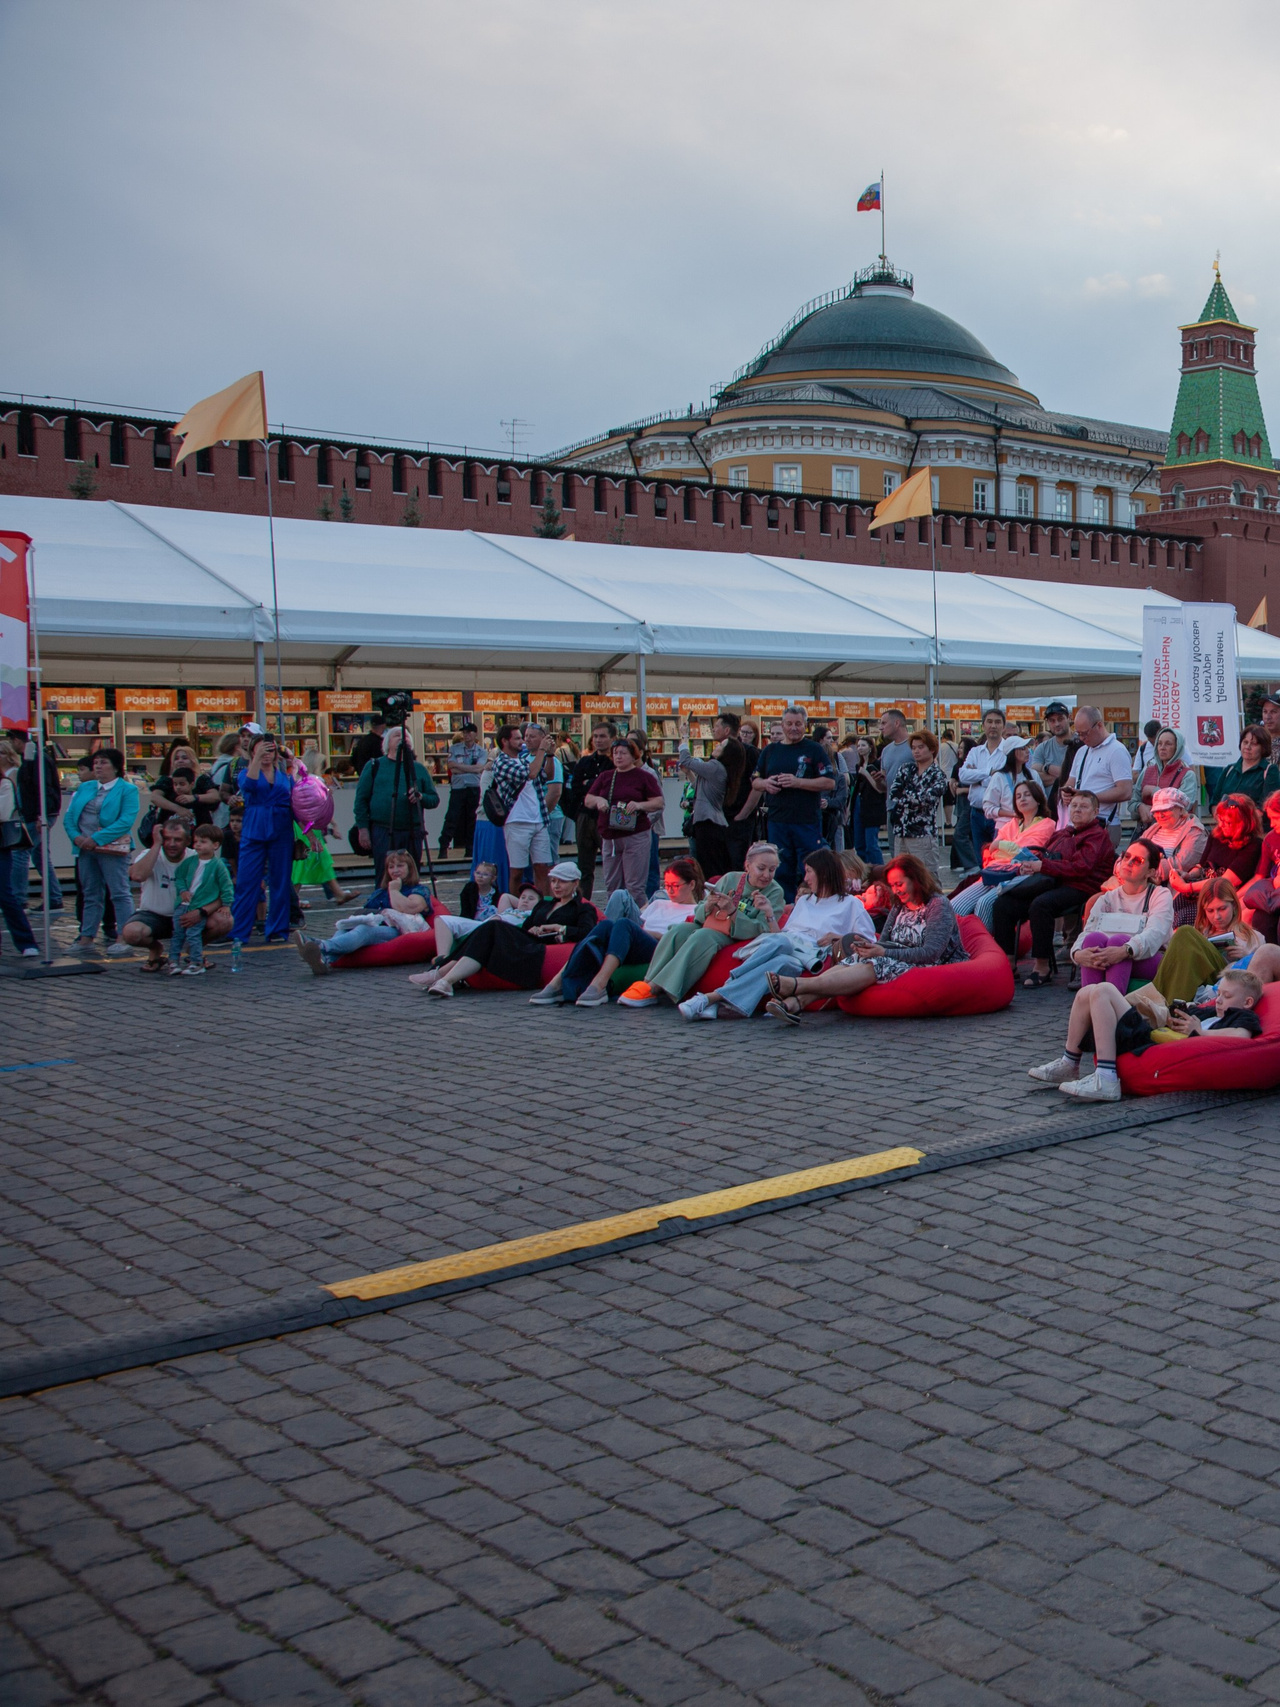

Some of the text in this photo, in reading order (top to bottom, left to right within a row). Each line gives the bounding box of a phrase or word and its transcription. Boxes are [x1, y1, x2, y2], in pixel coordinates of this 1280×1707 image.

[50, 696, 96, 704] РОБИНС
[125, 696, 170, 705] РОСМЭН
[196, 697, 238, 706] РОСМЭН
[264, 698, 303, 706] РОСМЭН
